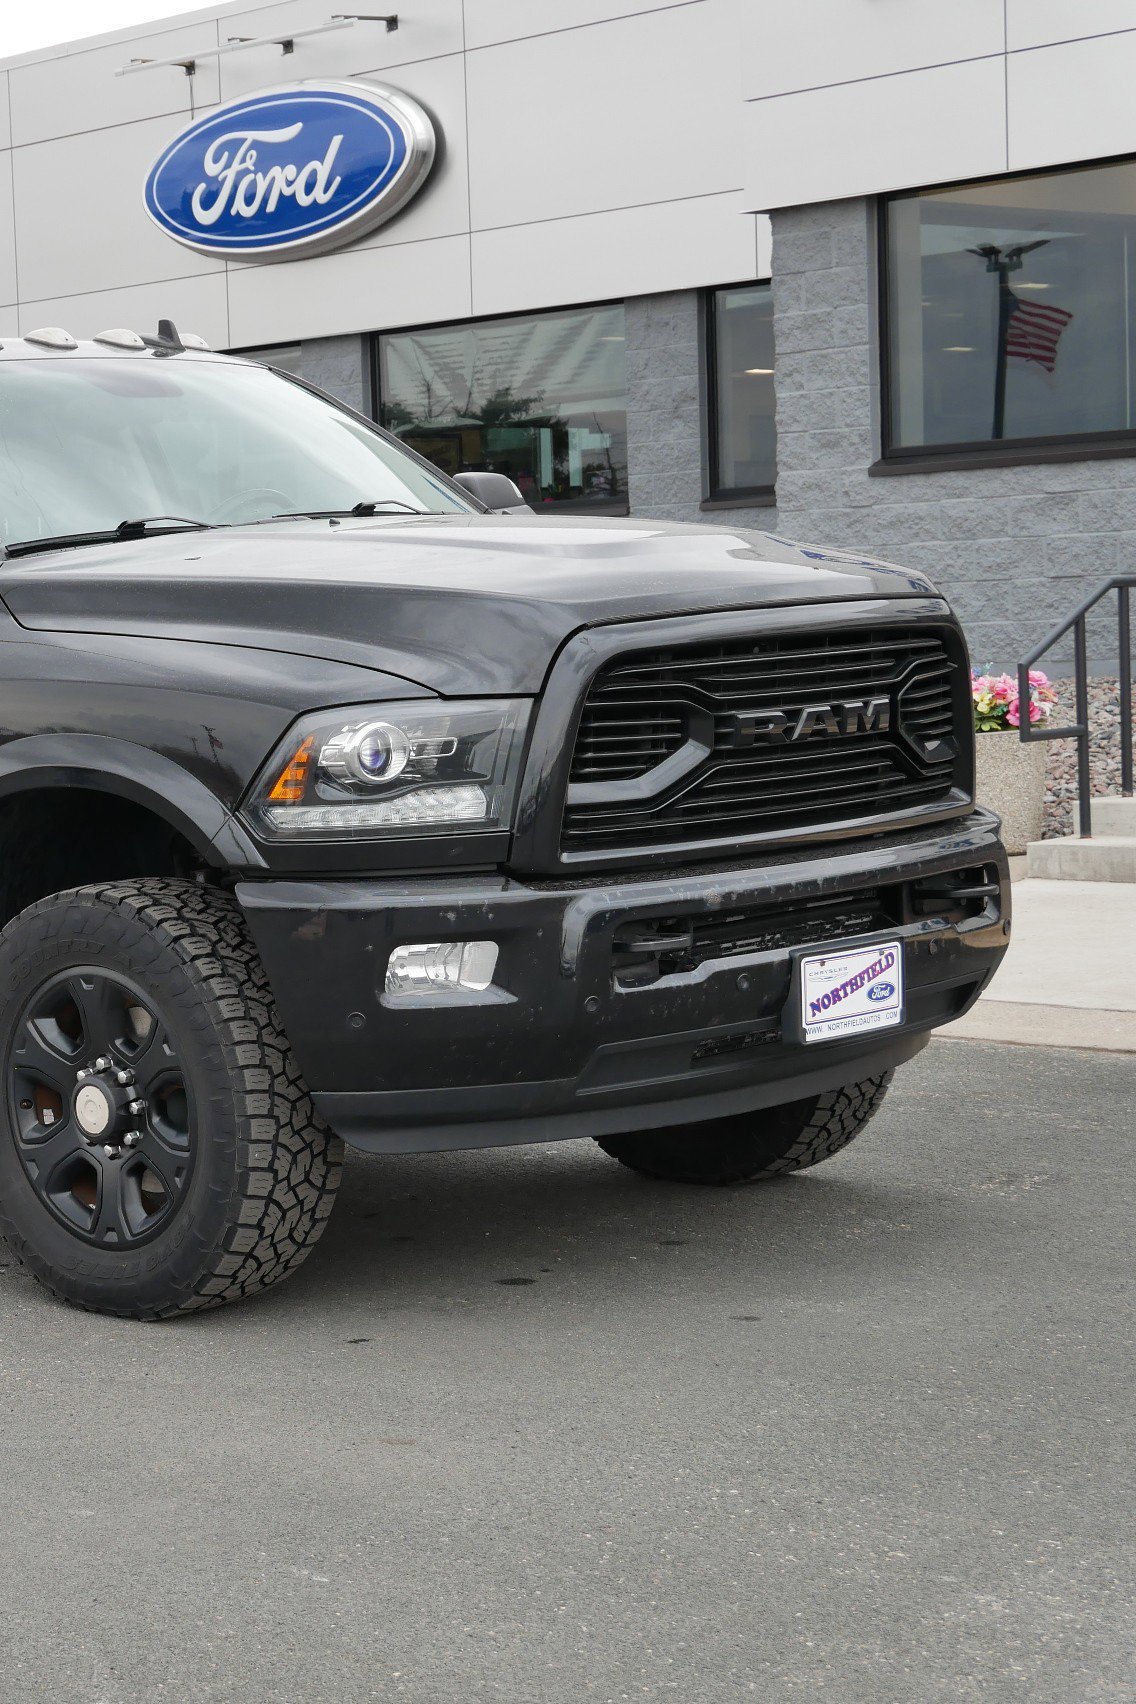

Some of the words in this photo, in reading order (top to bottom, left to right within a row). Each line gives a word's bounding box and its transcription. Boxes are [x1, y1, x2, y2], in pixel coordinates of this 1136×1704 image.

[191, 121, 344, 226] Ford
[734, 696, 891, 748] RAM
[808, 966, 849, 977] CHRYSLER
[809, 951, 895, 1018] NORTHFIELD
[871, 984, 891, 1000] Ford
